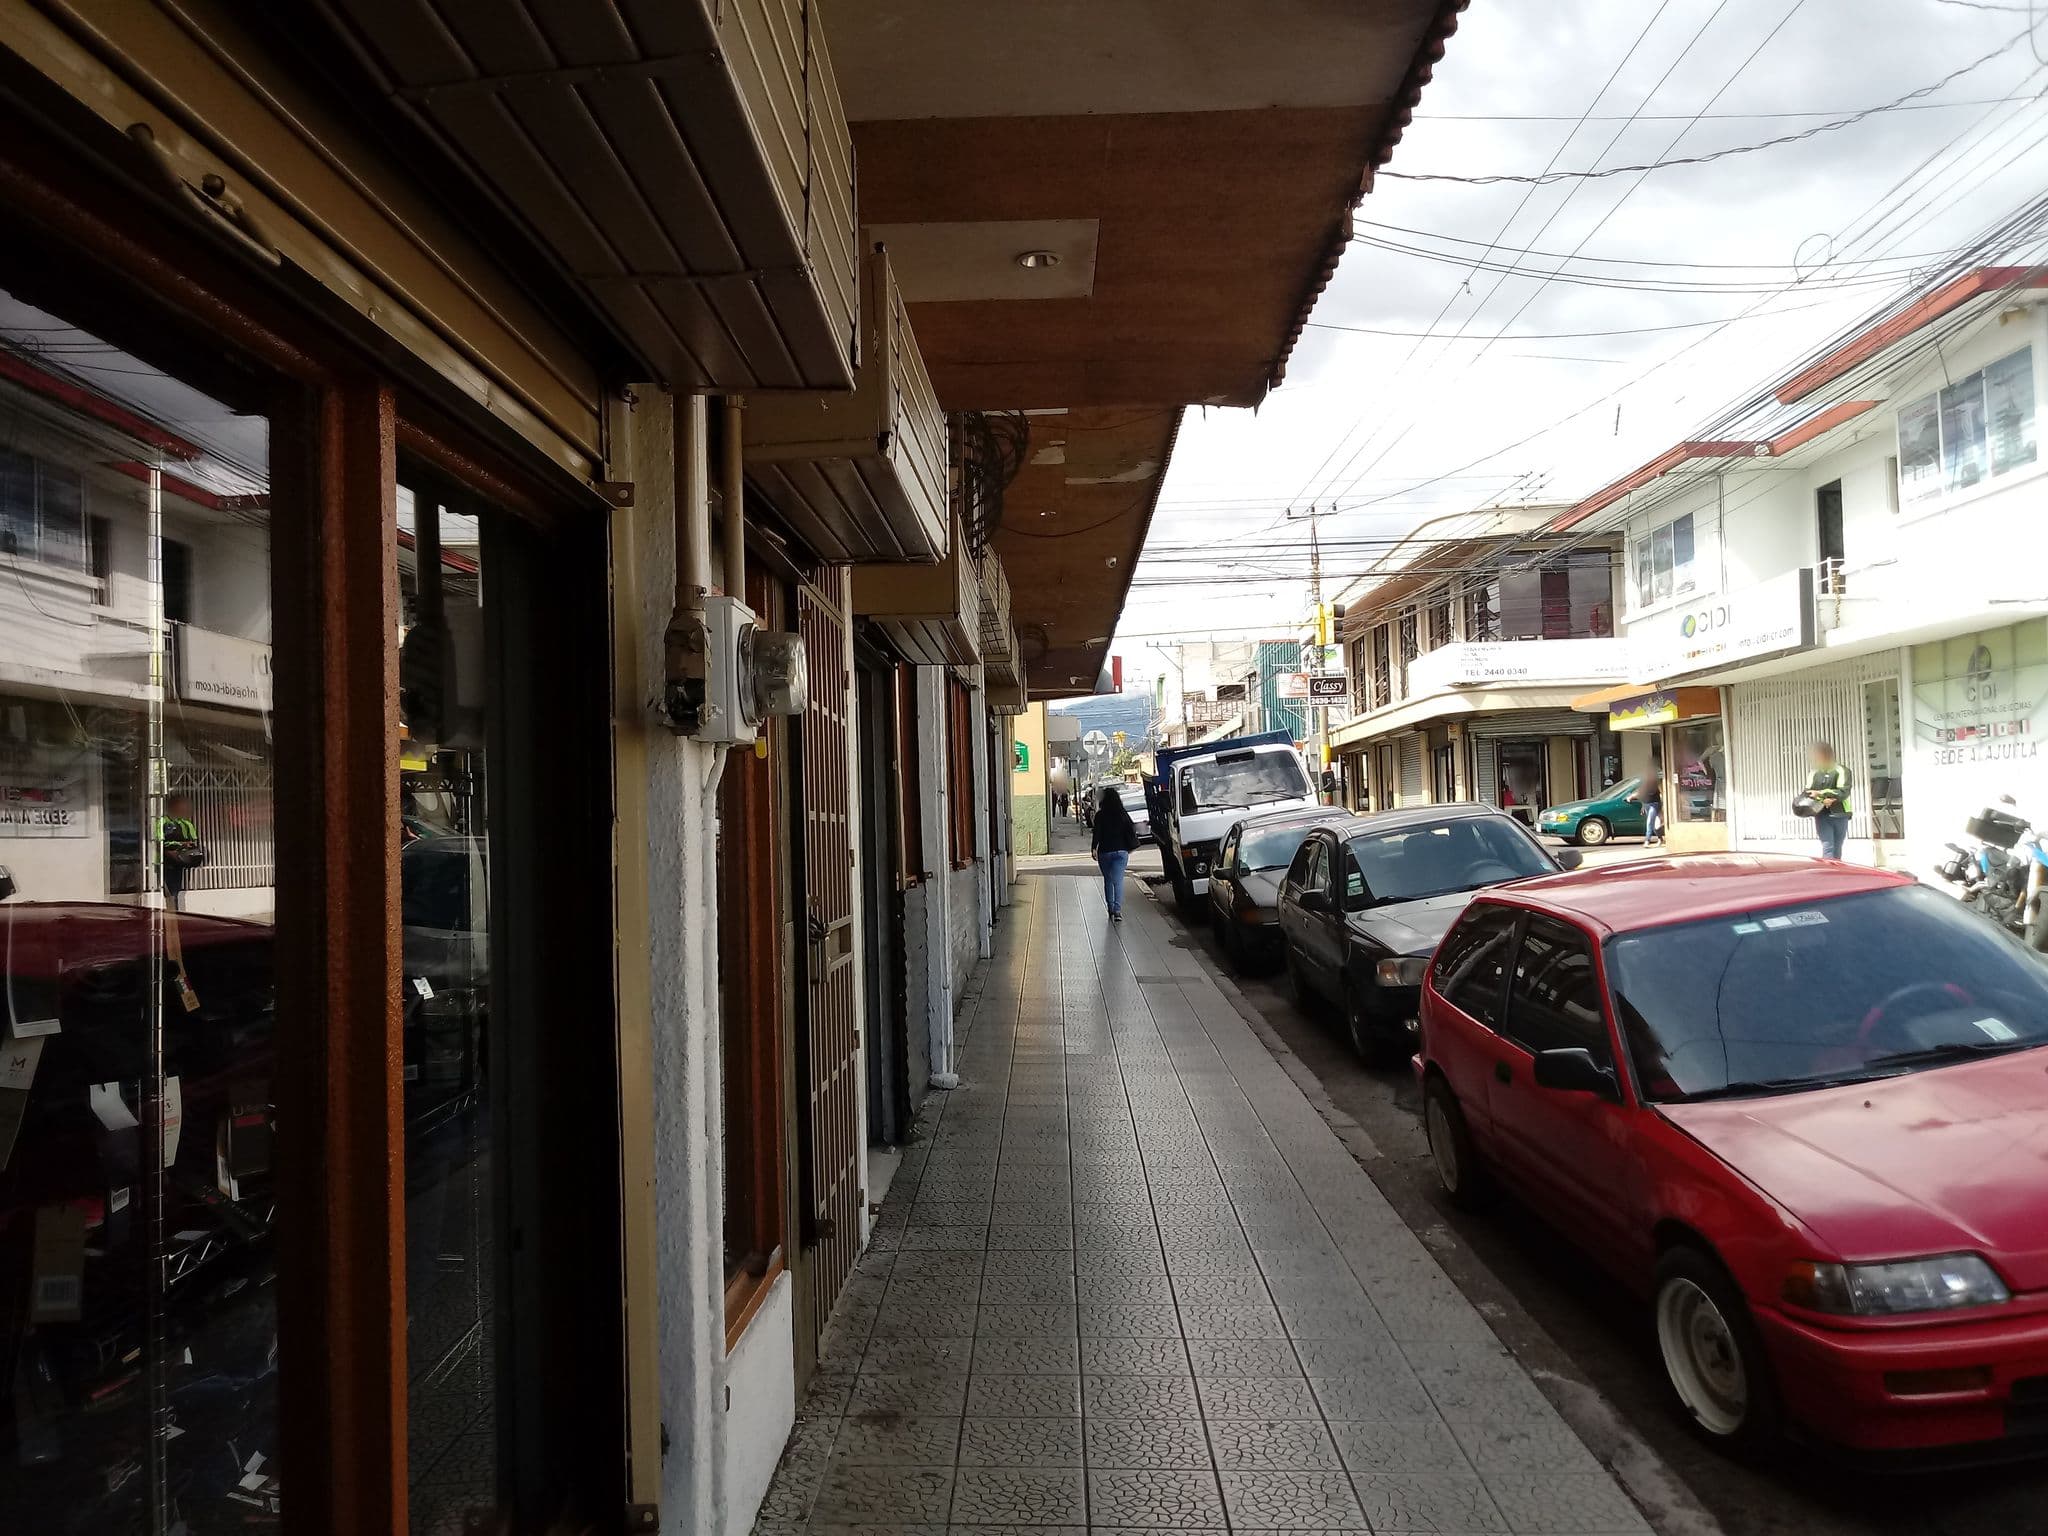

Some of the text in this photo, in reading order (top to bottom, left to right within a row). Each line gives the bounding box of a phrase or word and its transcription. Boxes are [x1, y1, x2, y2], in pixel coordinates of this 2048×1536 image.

[1698, 604, 1731, 633] CIDI
[1484, 668, 1504, 676] 2440
[1507, 667, 1528, 675] 0340
[1313, 680, 1343, 693] Classy
[1967, 682, 1997, 702] CDI
[1934, 741, 2038, 766] SEDE AAJUELA
